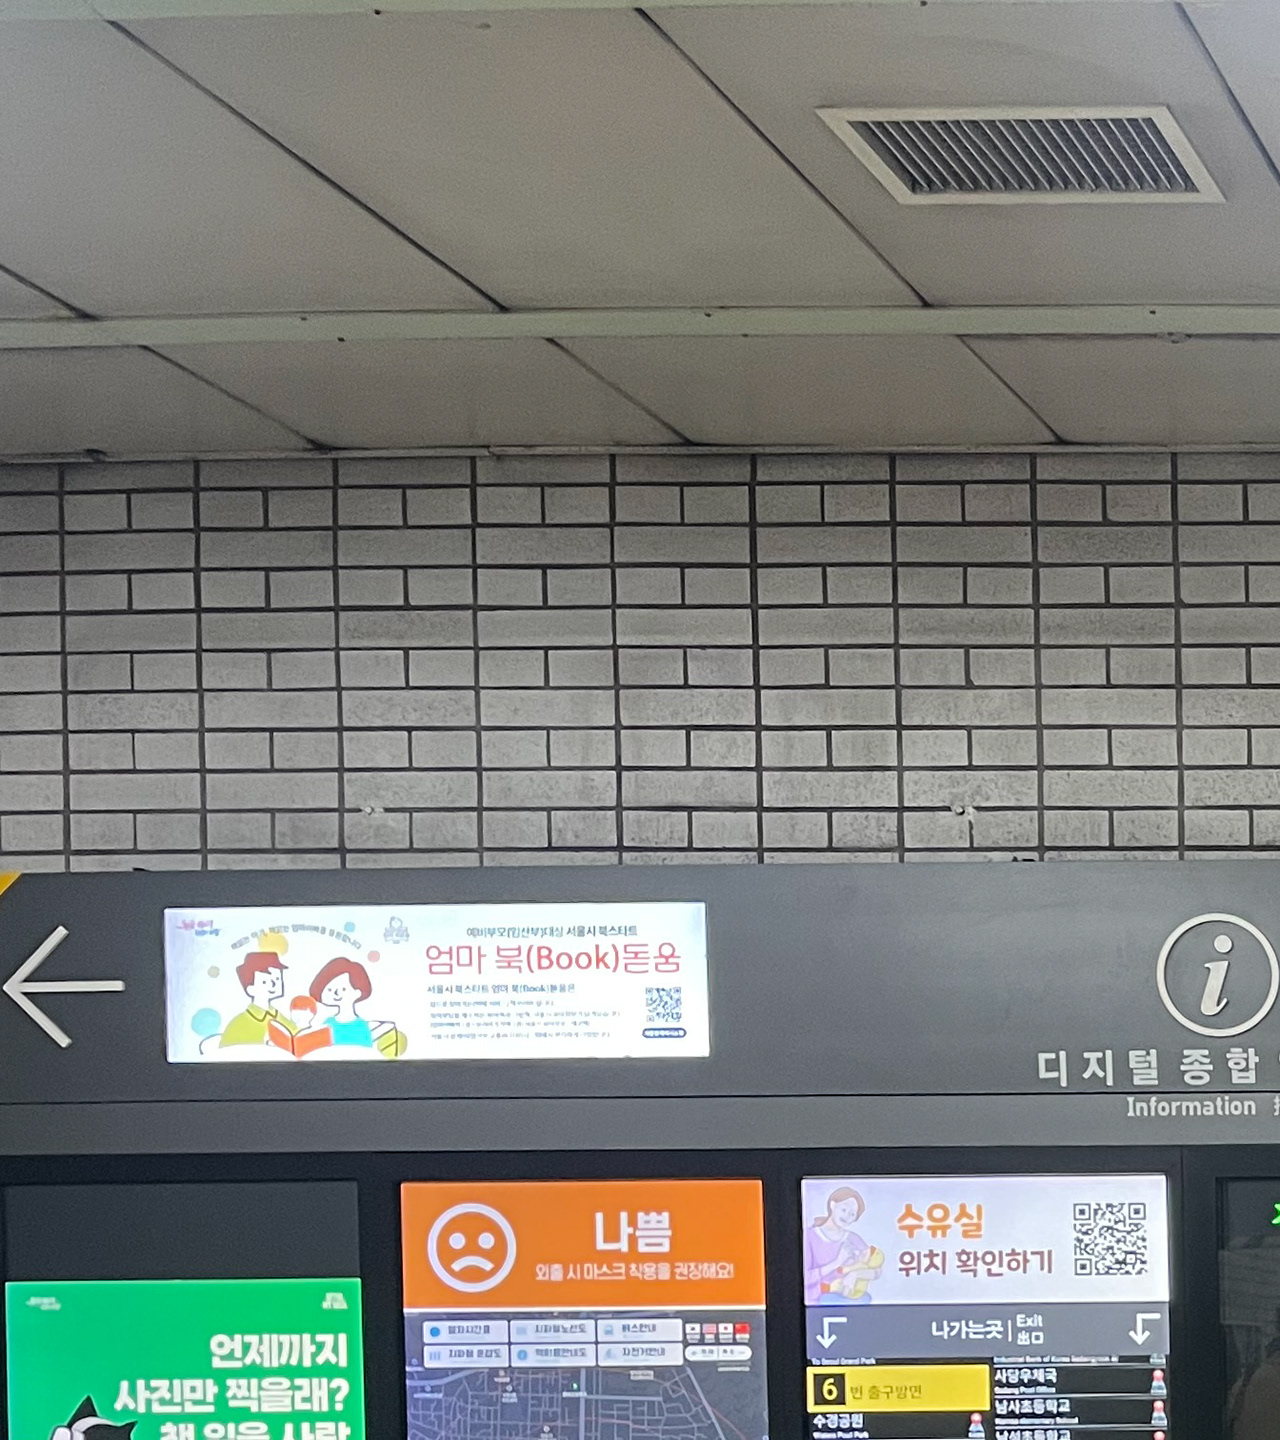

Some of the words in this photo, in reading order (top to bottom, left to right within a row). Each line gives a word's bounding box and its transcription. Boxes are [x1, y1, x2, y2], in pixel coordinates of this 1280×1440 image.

[425, 944, 487, 975] 엄마
[495, 942, 682, 974] 북(Book)돋움
[1037, 1048, 1159, 1087] 디지털
[1180, 1047, 1260, 1086] 종합
[1127, 1096, 1257, 1117] Information
[595, 1211, 672, 1253] 나쁨
[896, 1203, 984, 1239] 수유실
[567, 1263, 580, 1280] 시
[584, 1262, 626, 1281] 마스크
[898, 1250, 948, 1276] 위치
[955, 1248, 1053, 1278] 확인하기
[931, 1320, 1004, 1340] 나가는곳
[1016, 1313, 1044, 1328] Exit
[210, 1333, 348, 1369] 언제까지
[1016, 1332, 1045, 1345] 出口
[113, 1379, 218, 1413] 사진만
[225, 1377, 349, 1413] 찍을래?
[822, 1378, 838, 1400] 6
[868, 1385, 922, 1400] 출구방면
